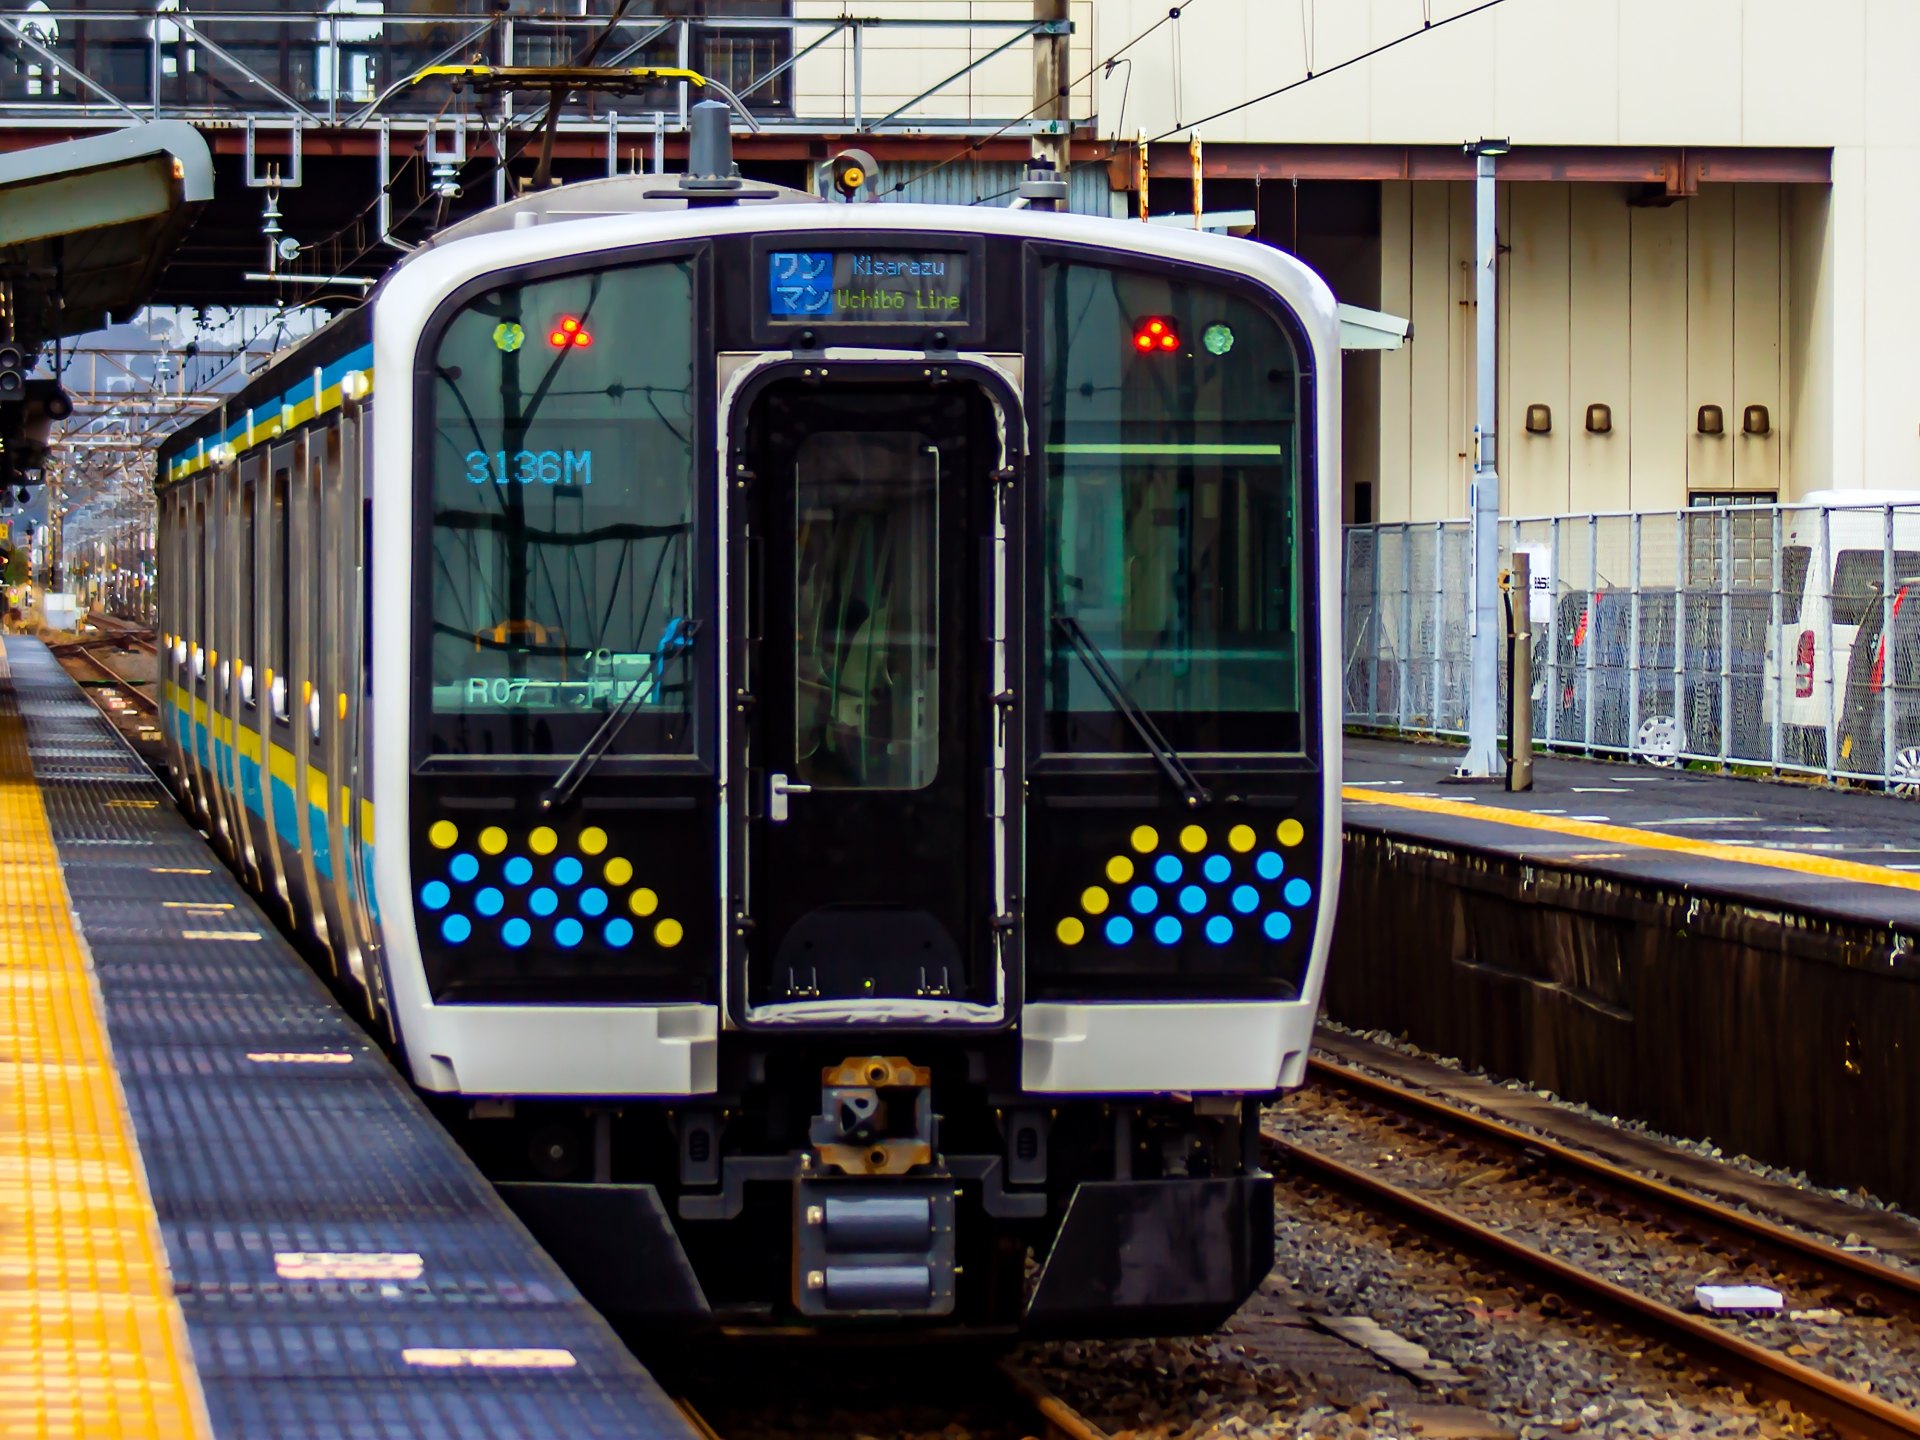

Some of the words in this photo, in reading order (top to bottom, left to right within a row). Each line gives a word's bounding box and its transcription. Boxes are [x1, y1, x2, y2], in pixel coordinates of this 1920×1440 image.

[774, 253, 825, 279] ワン
[853, 255, 944, 275] Kisarazu
[776, 285, 829, 311] マン
[837, 289, 905, 310] Uchibō
[916, 289, 960, 310] Line
[466, 450, 592, 484] 3136M
[469, 678, 530, 704] R07
